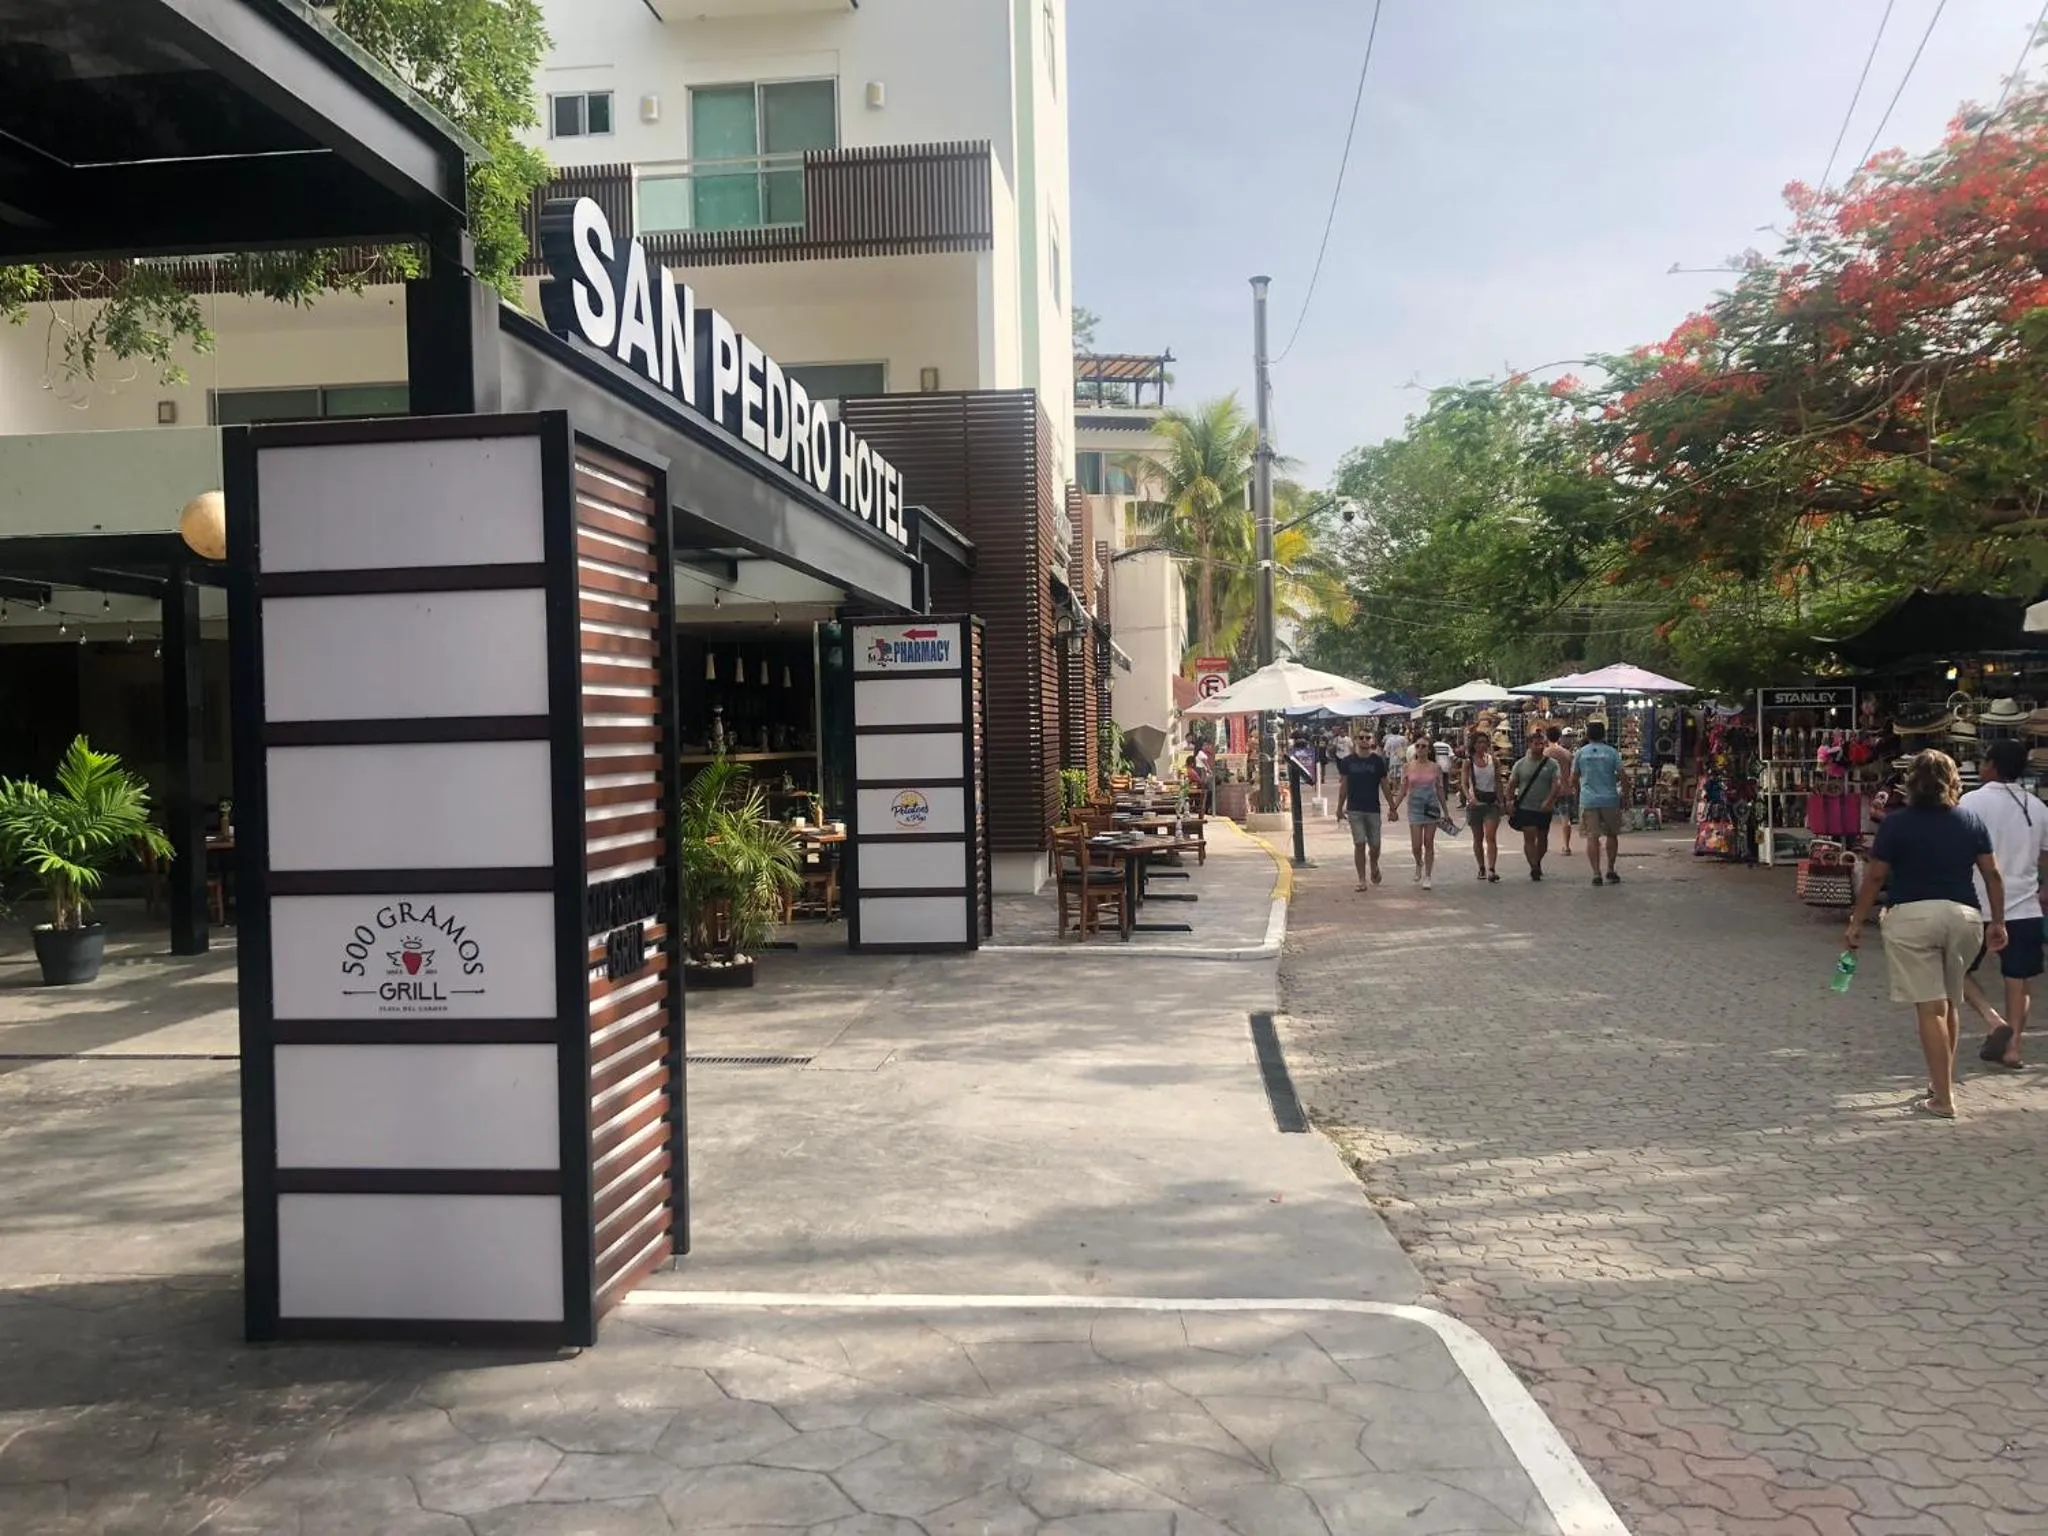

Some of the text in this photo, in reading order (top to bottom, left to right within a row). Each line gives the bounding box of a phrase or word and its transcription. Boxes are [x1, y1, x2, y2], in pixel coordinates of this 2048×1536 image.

[572, 197, 909, 547] SAN PEDRO HOTEL
[893, 640, 950, 663] PHARMACY
[1775, 692, 1837, 704] STANLEY
[342, 901, 484, 977] 500 GRAMOS
[379, 981, 447, 1001] GRILL
